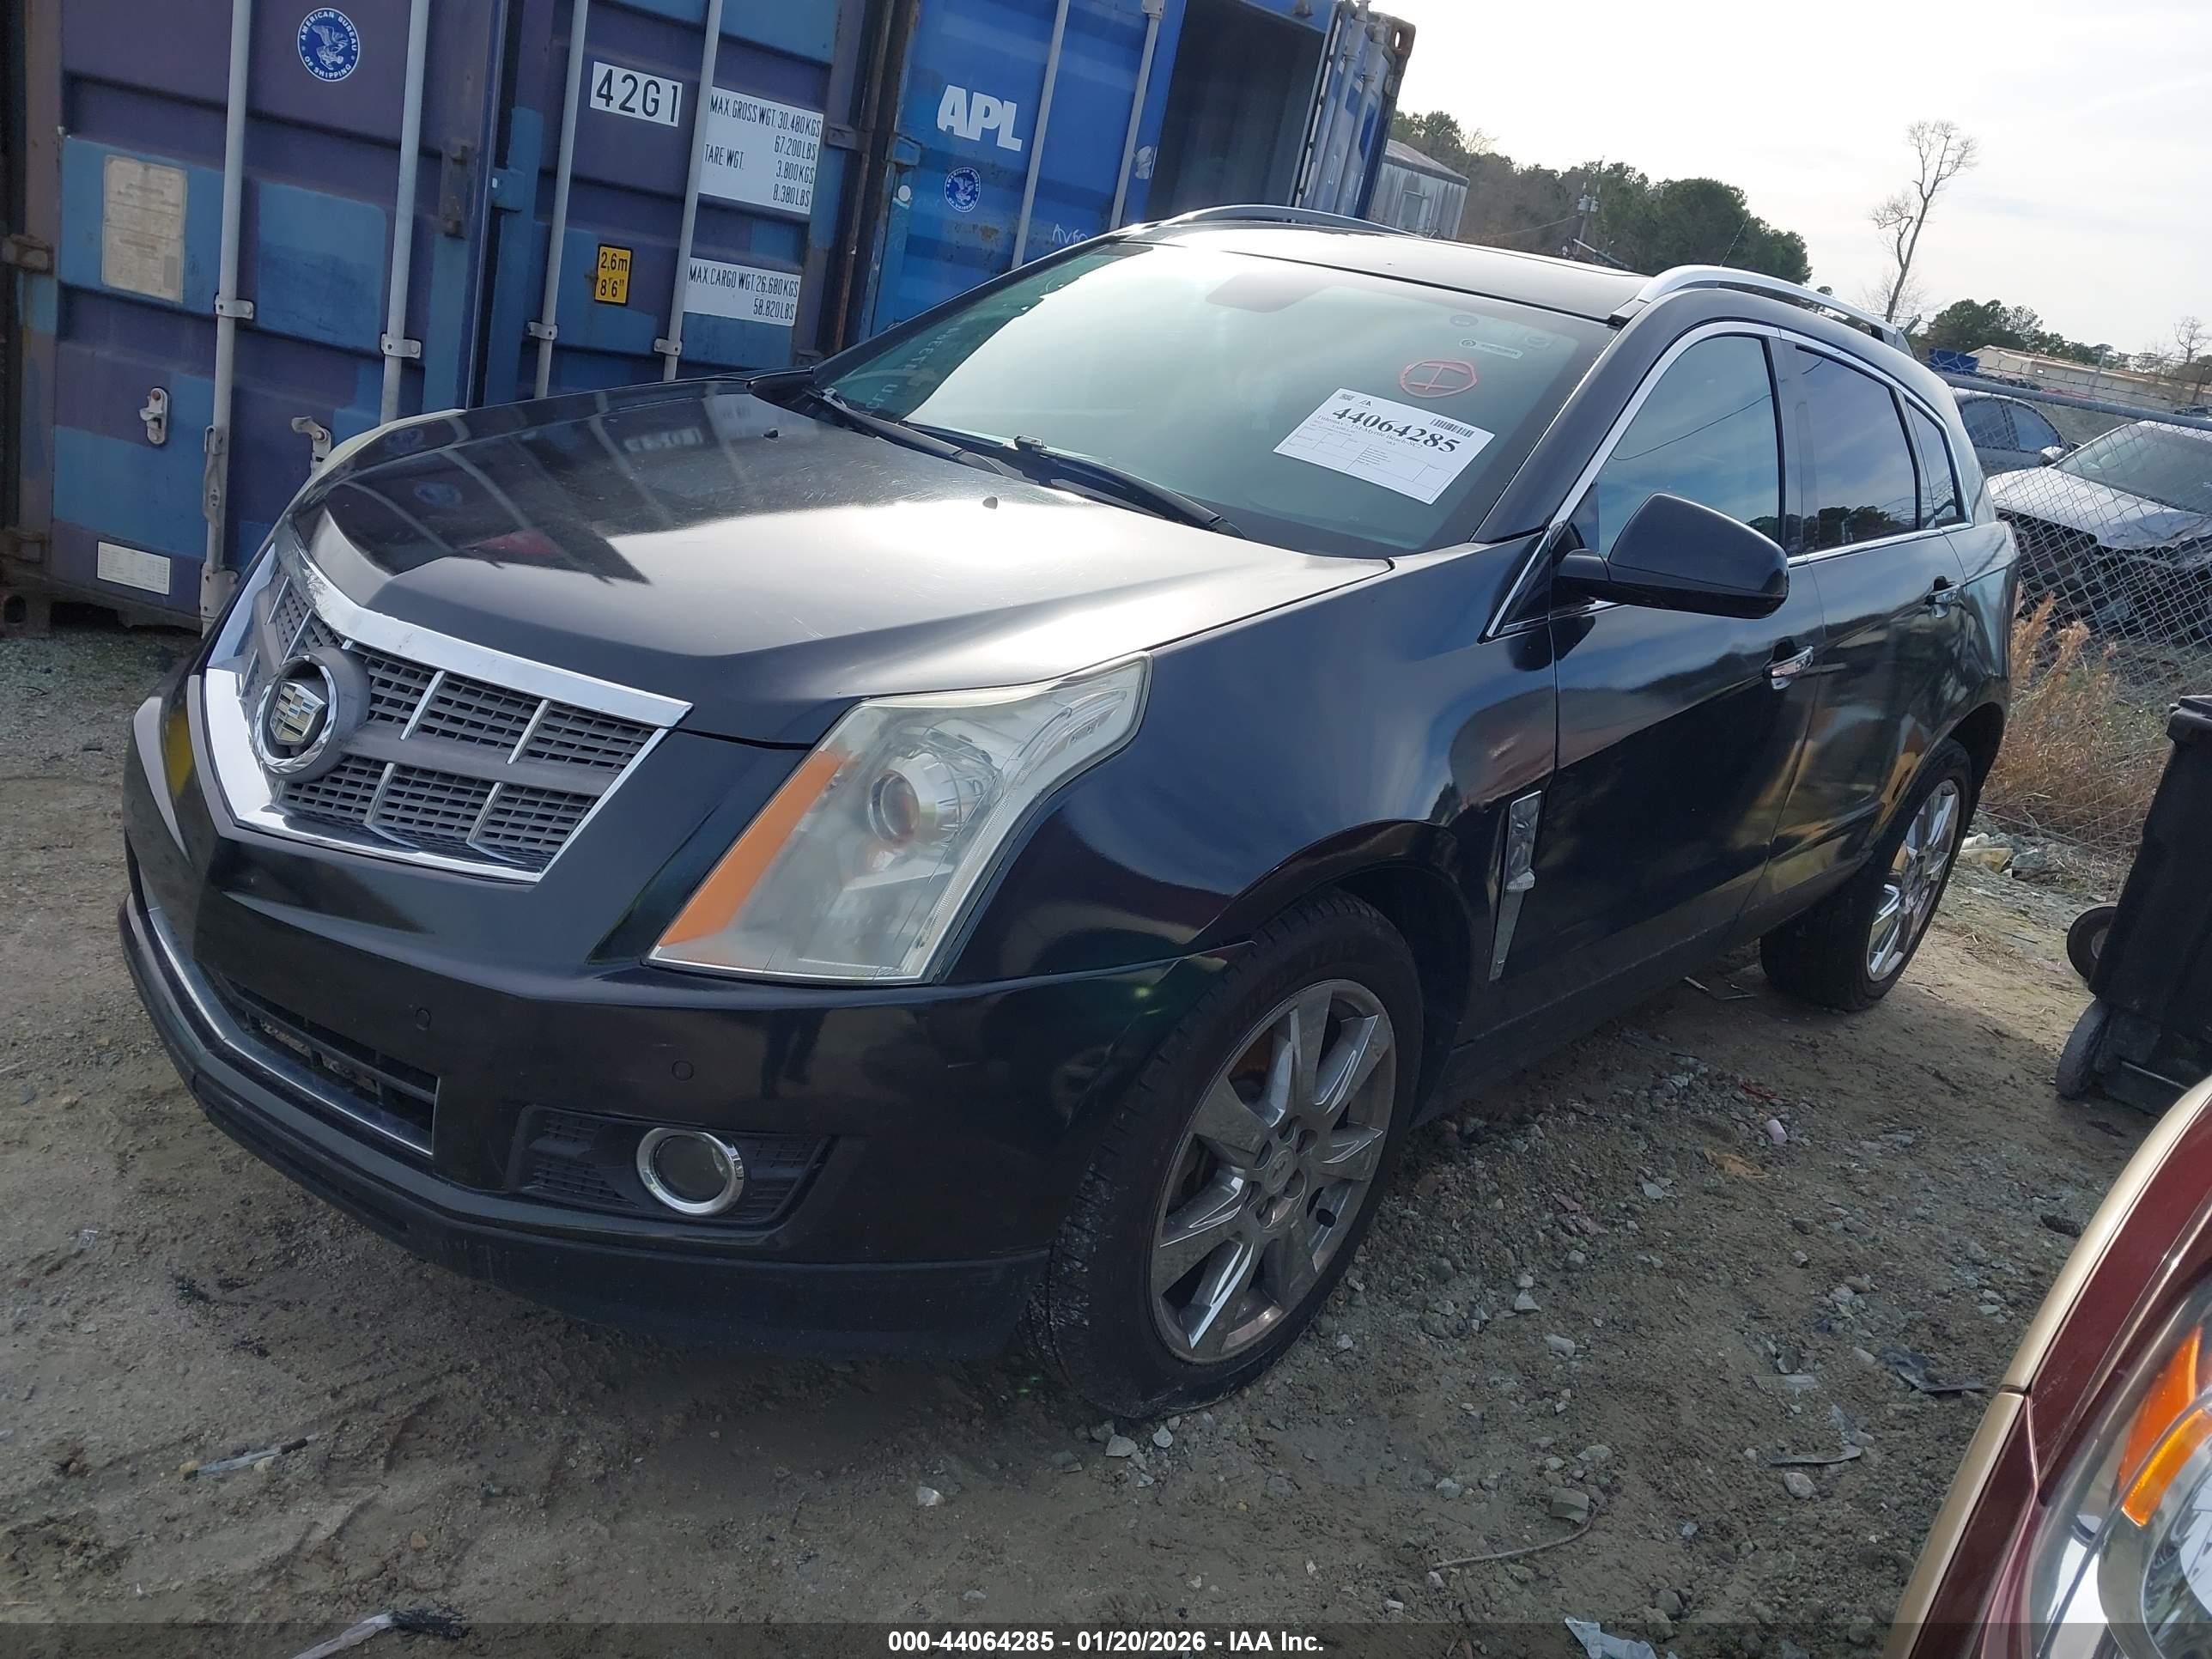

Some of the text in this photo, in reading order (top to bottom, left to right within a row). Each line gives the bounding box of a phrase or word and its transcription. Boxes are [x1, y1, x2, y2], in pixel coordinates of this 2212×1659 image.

[301, 11, 335, 40] AMERICAN
[337, 16, 357, 52] BUREAU
[313, 64, 351, 78] SHIPPING
[596, 68, 678, 123] 42G1
[732, 100, 757, 123] GROSS
[758, 106, 776, 128] WGT.
[937, 84, 1023, 152] APL
[704, 143, 725, 166] TARE
[726, 148, 744, 170] WGT.
[710, 267, 738, 289] CARGO
[1332, 407, 1462, 453] 44064285
